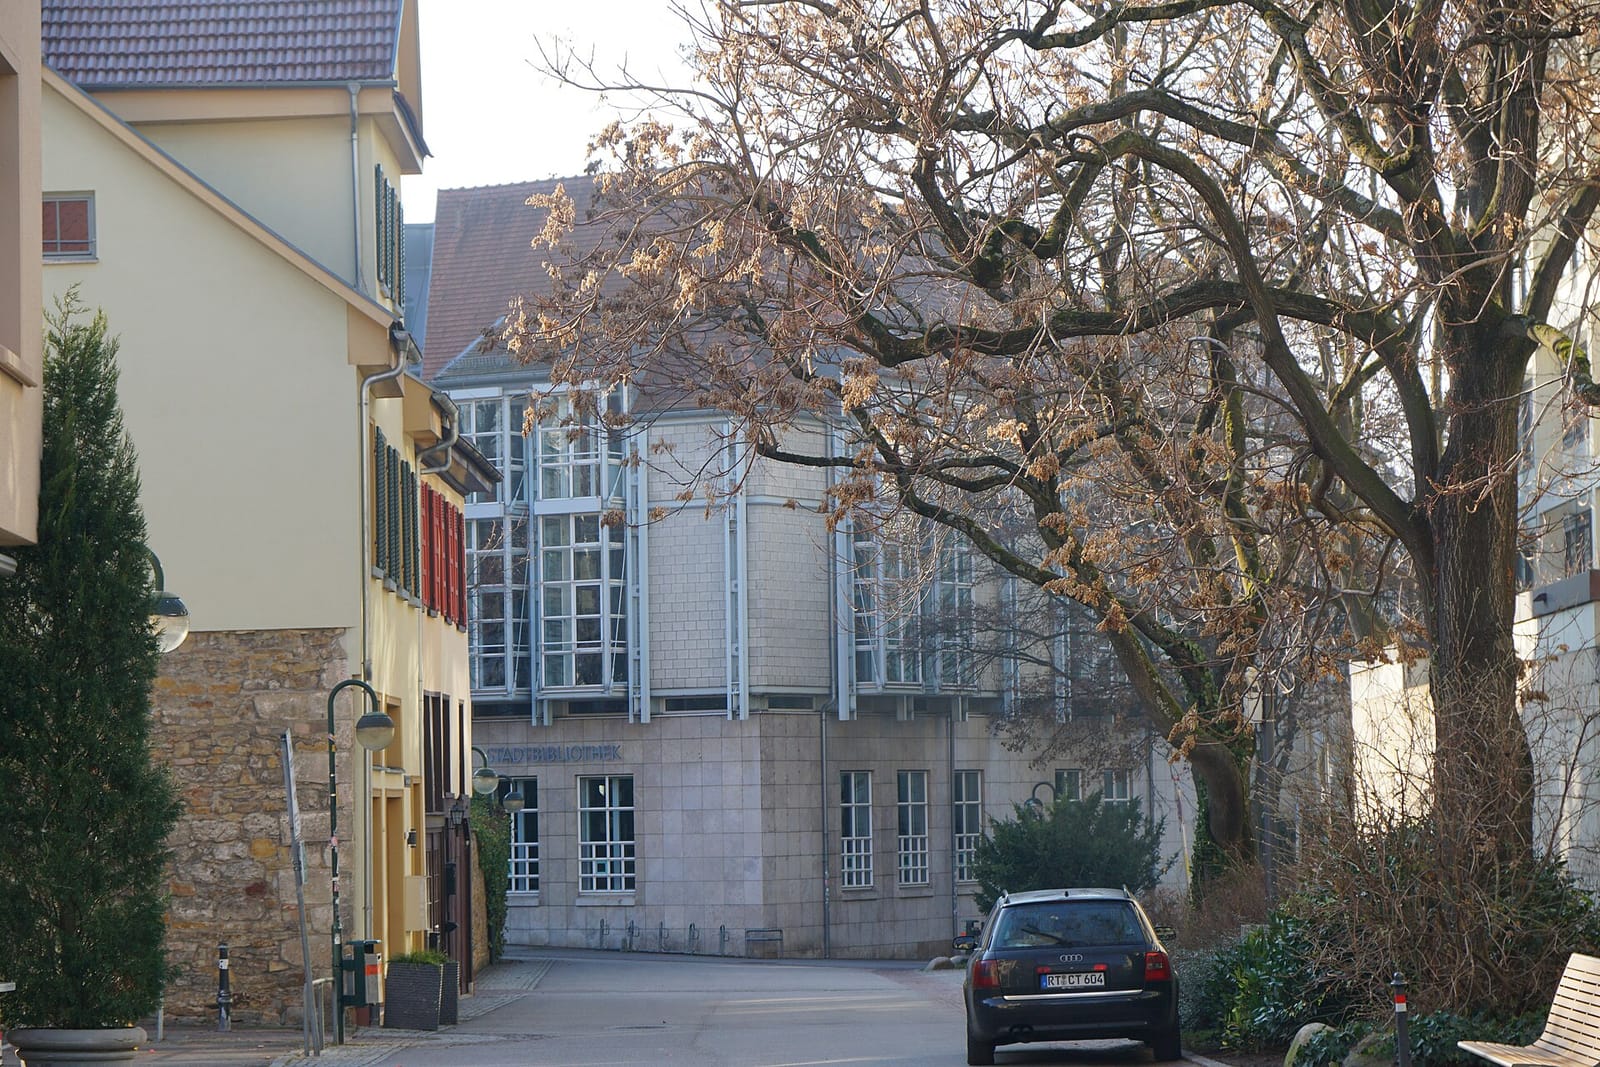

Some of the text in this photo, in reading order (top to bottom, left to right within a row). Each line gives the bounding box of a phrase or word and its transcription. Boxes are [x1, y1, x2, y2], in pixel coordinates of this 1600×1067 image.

[487, 745, 622, 763] STADTBIBLIOTHEK
[1047, 974, 1103, 986] RT CT 604
